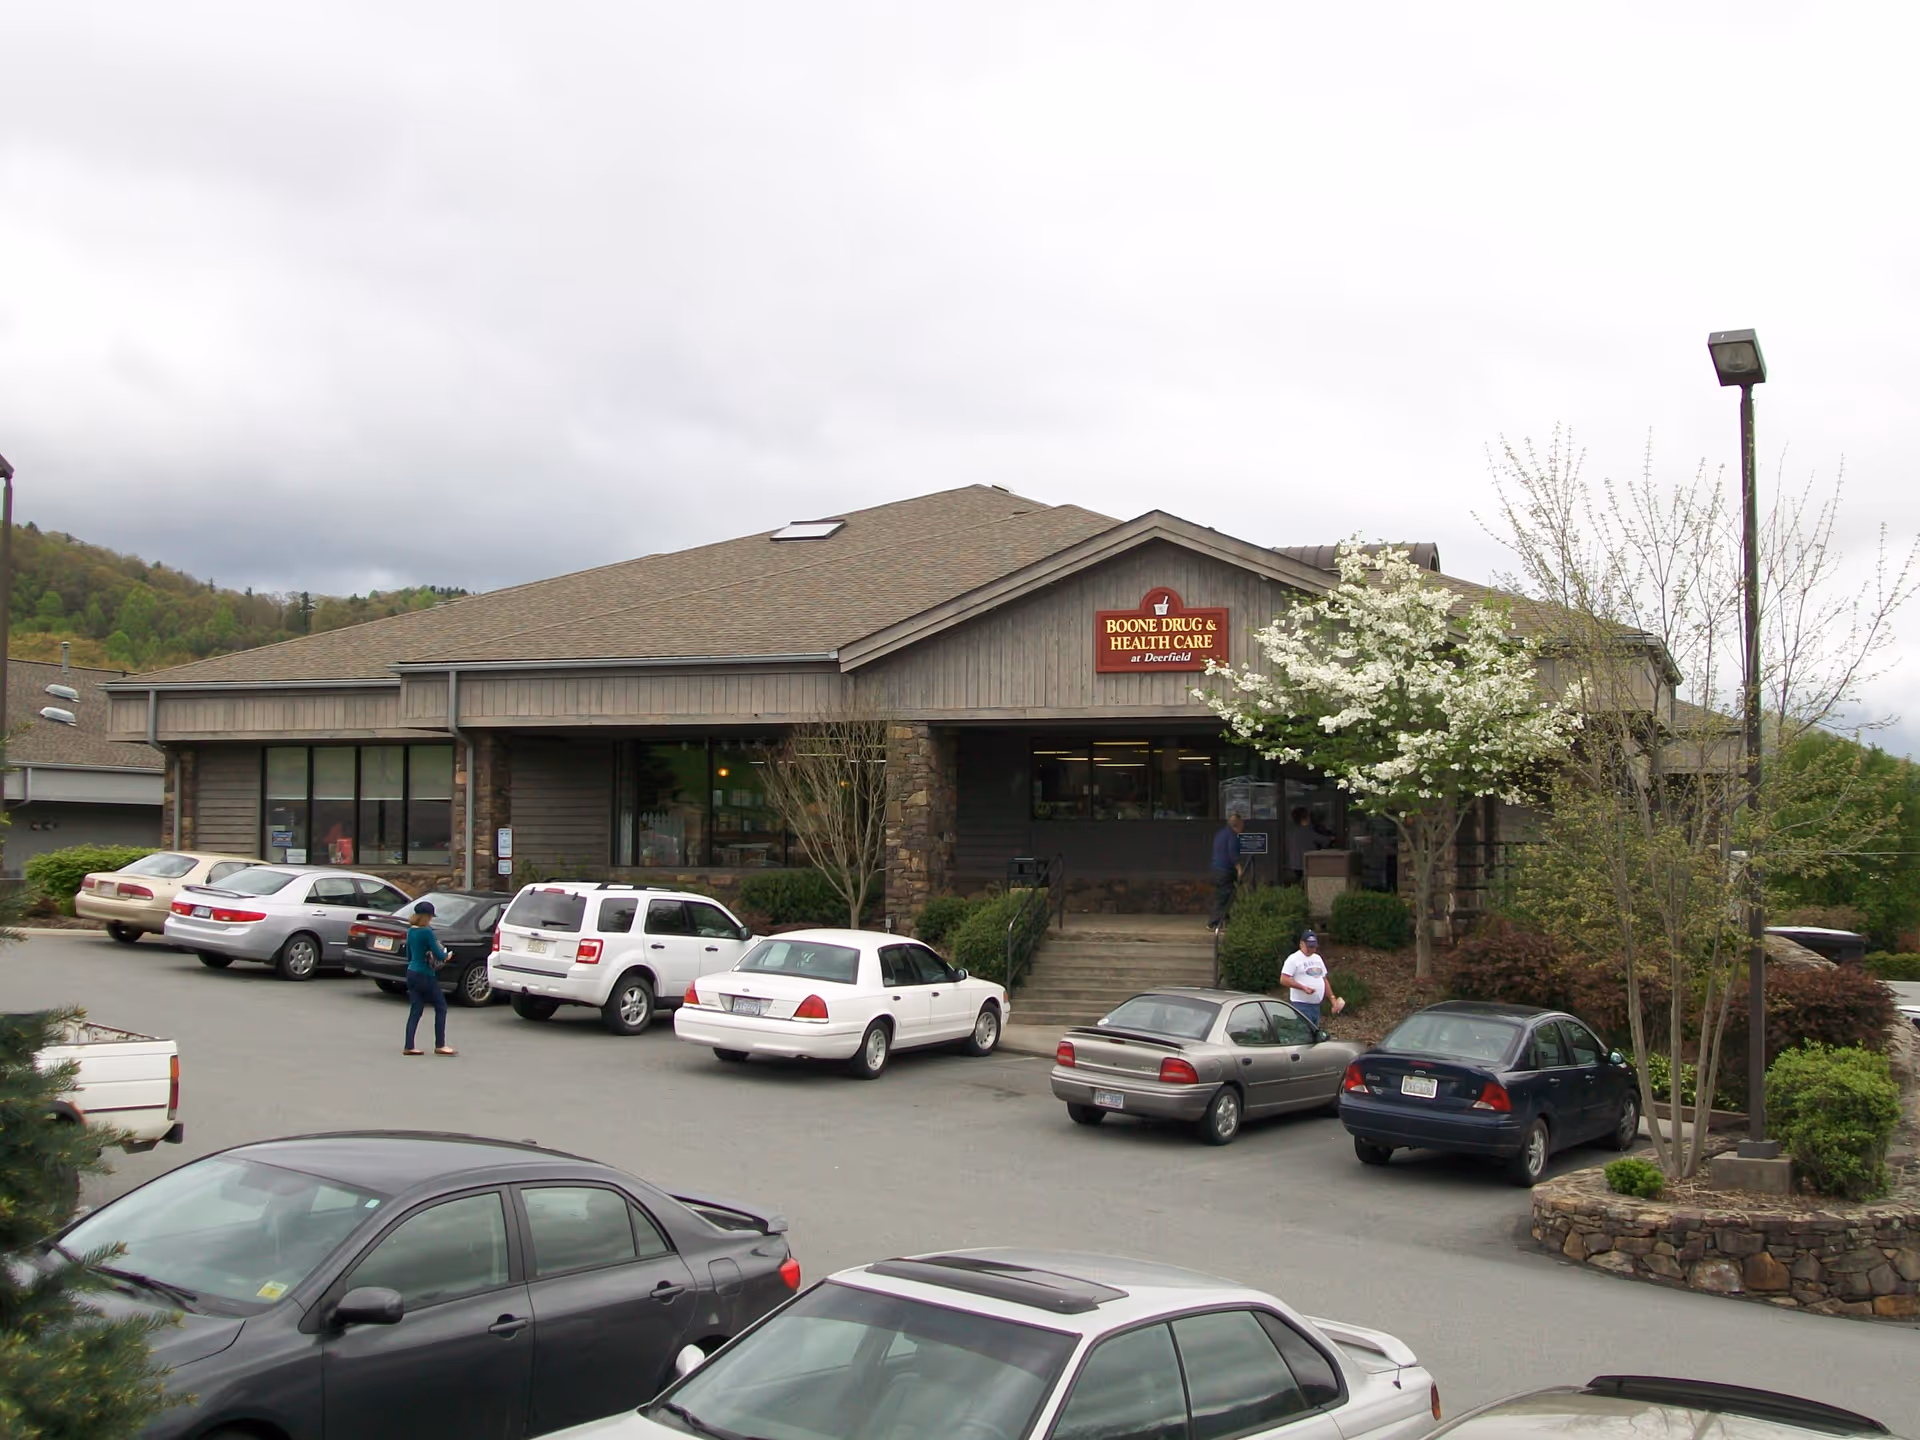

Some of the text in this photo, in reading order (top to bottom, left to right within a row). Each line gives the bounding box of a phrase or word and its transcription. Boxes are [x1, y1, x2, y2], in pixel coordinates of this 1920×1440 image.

[1106, 617, 1217, 633] BOONE DRUG &
[1110, 634, 1213, 650] HEALTH CARE
[1144, 652, 1191, 662] Deerfield
